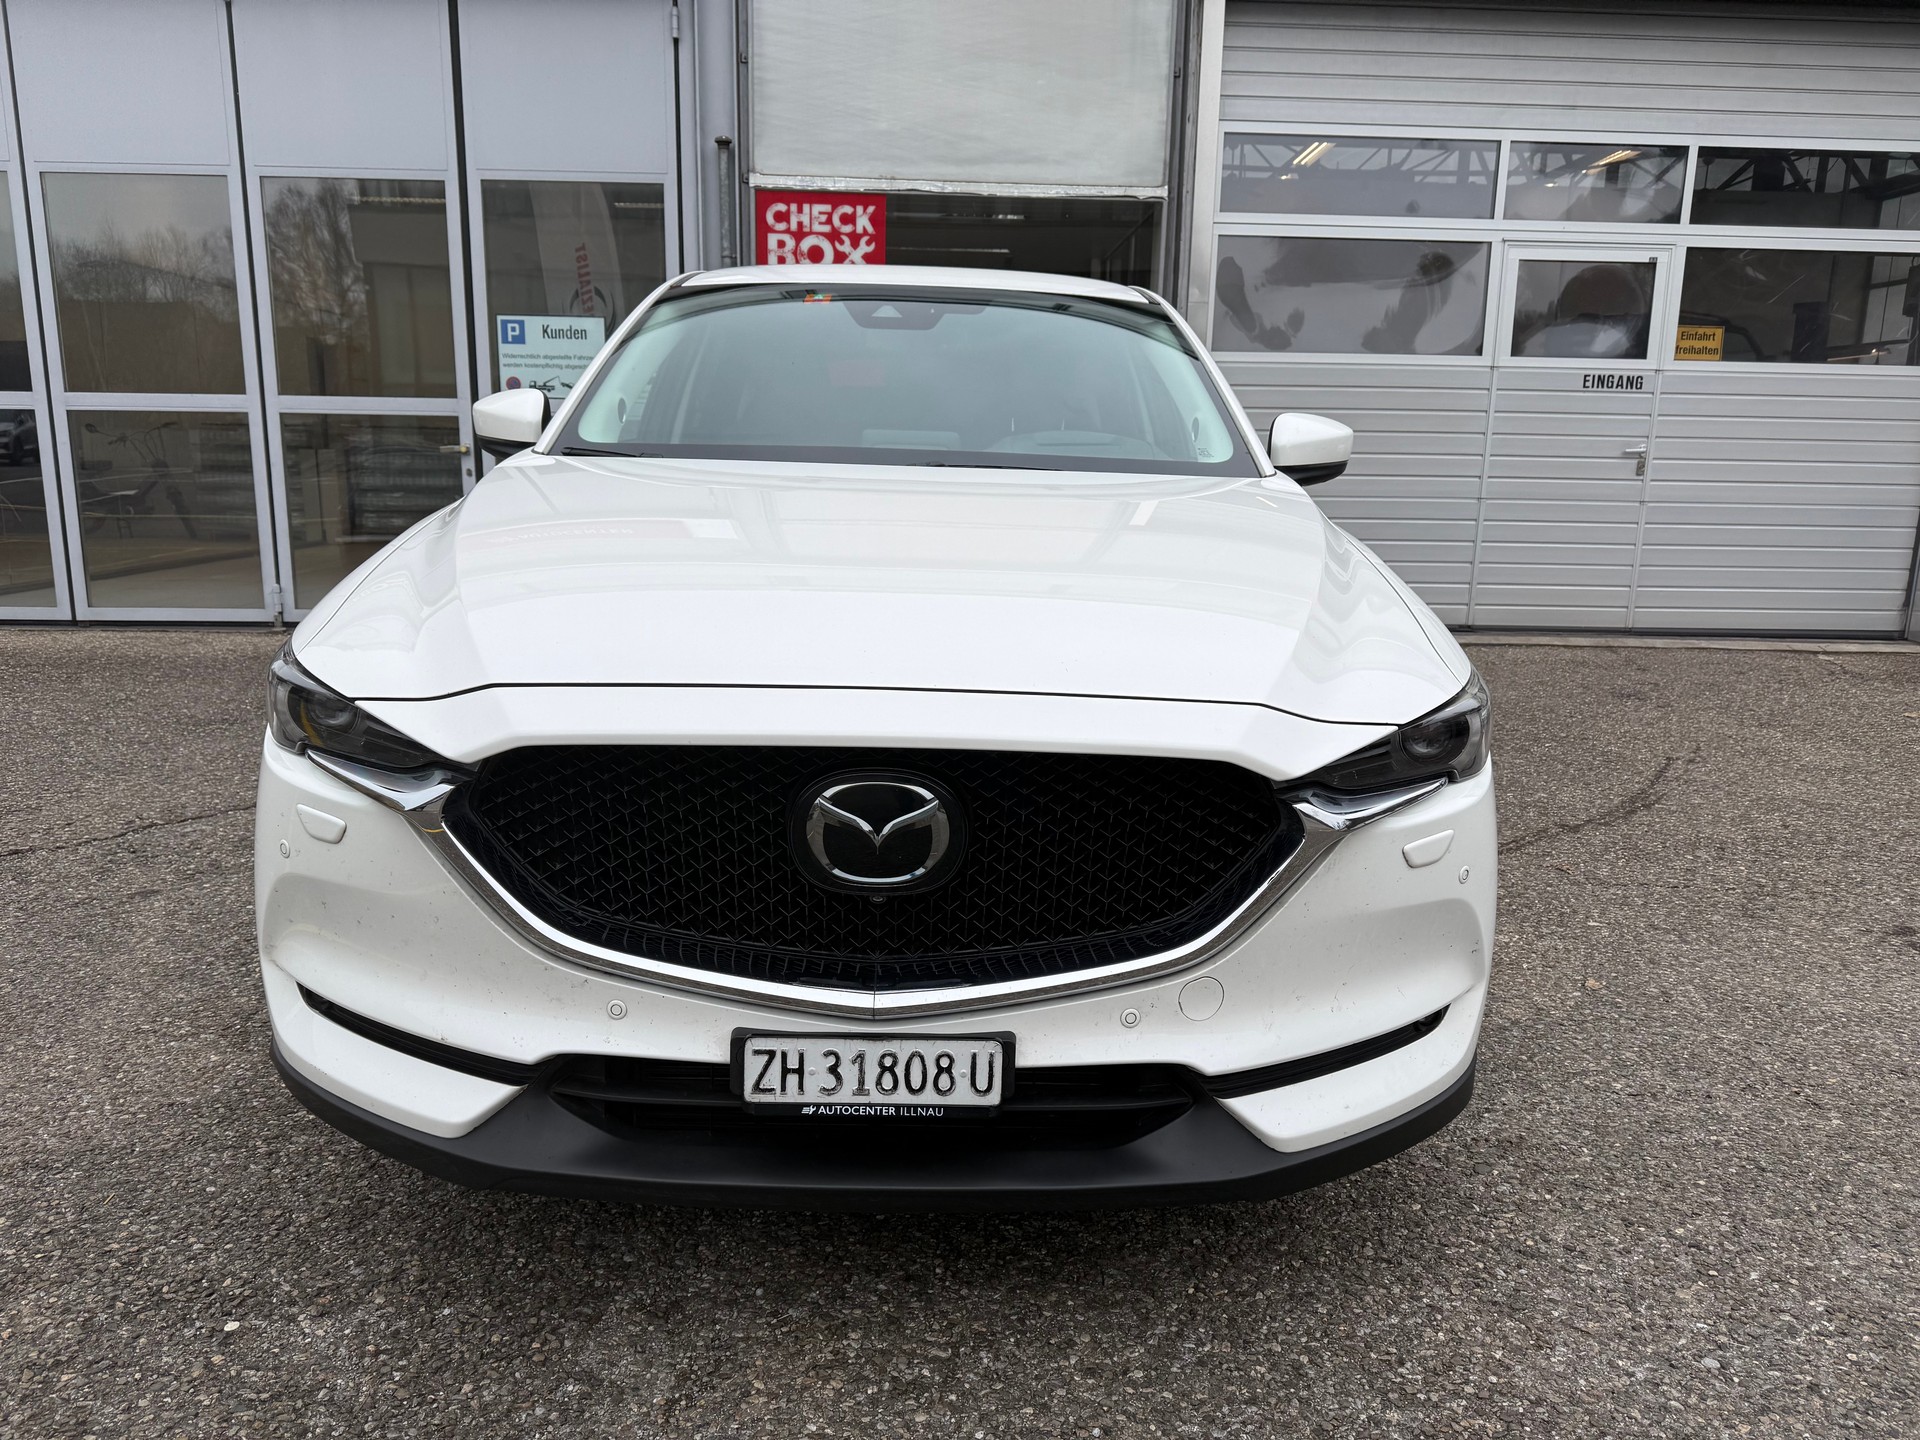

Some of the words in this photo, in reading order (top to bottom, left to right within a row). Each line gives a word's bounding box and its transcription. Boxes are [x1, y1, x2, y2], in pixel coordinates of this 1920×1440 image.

[765, 202, 876, 234] CHECK
[766, 232, 876, 265] BOX
[506, 323, 520, 342] P
[541, 324, 587, 340] Kunden
[1680, 331, 1716, 342] Einfahrt
[1676, 345, 1719, 356] freihalten
[1583, 374, 1644, 390] EINGANG
[750, 1048, 805, 1096] ZH
[818, 1049, 957, 1097] 31808
[970, 1051, 996, 1097] U
[817, 1106, 896, 1116] AUTOCENTER
[900, 1107, 944, 1117] ILLNAU
